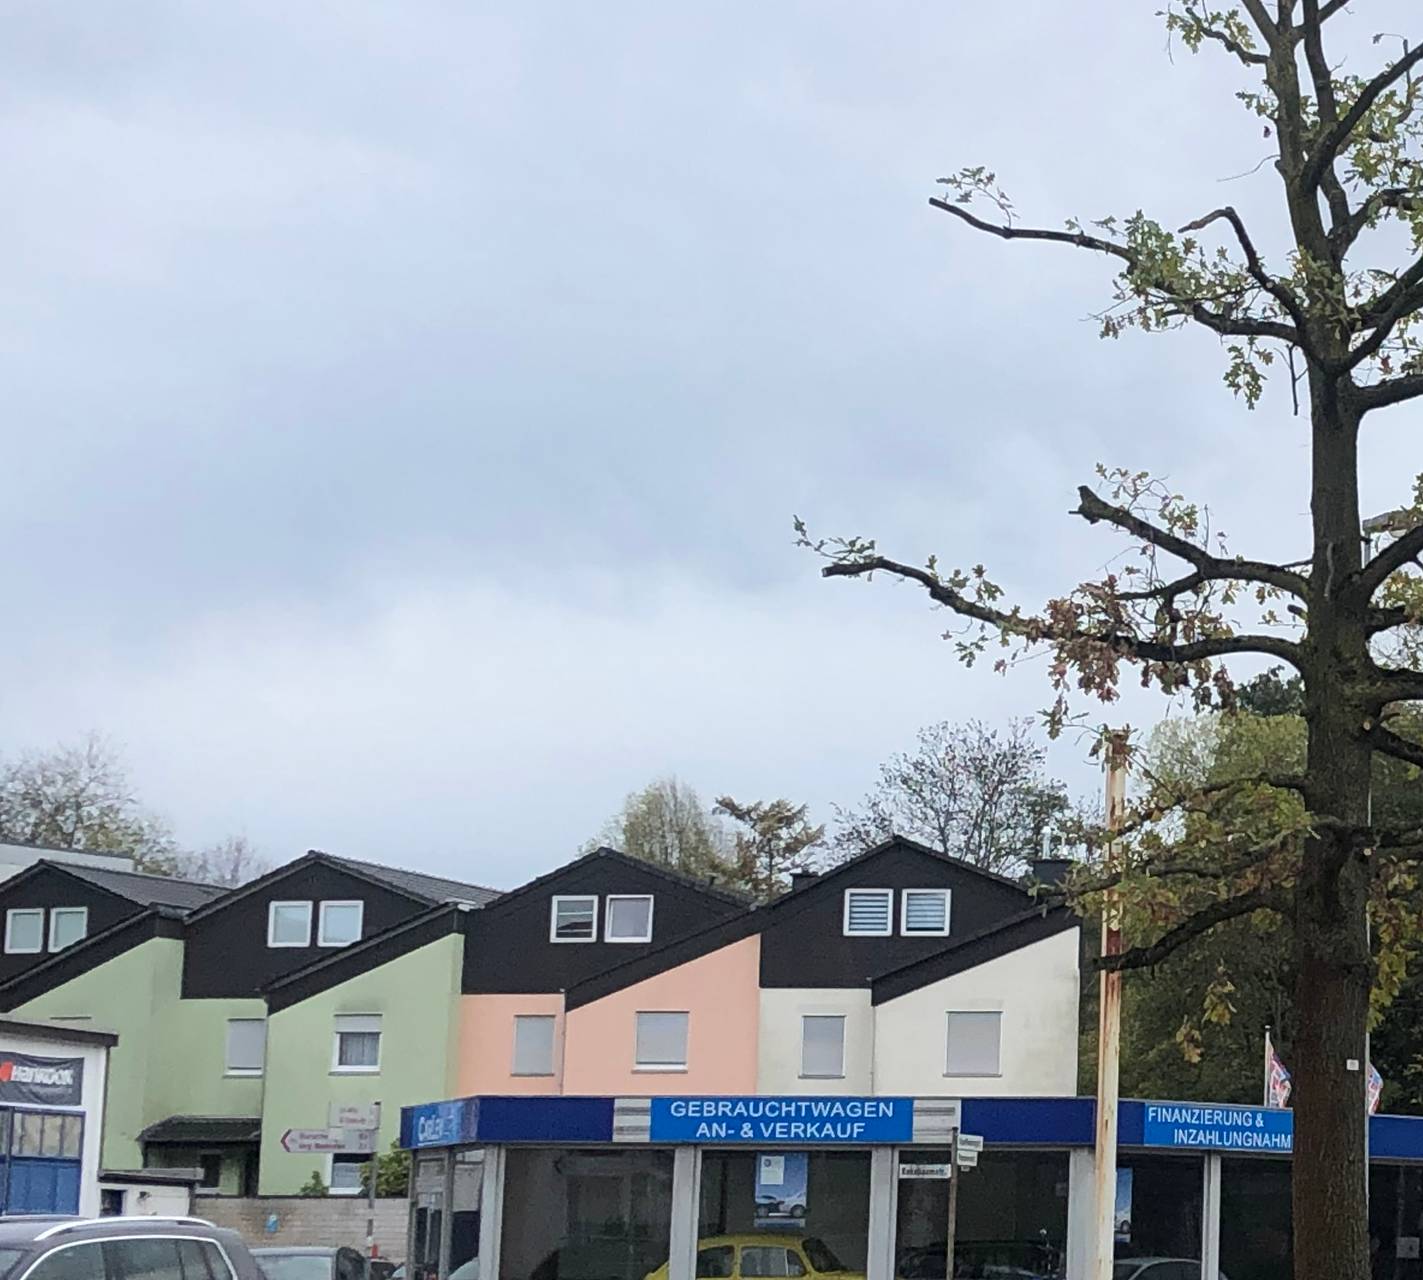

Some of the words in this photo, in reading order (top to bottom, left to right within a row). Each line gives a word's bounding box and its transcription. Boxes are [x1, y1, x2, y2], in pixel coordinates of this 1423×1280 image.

[670, 1101, 893, 1118] GEBRAUCHTWAGEN
[1148, 1107, 1252, 1127] FINANZIERUNG
[1255, 1112, 1264, 1128] &
[696, 1122, 735, 1139] AN-
[740, 1122, 754, 1139] &
[760, 1122, 866, 1138] VERKAUF
